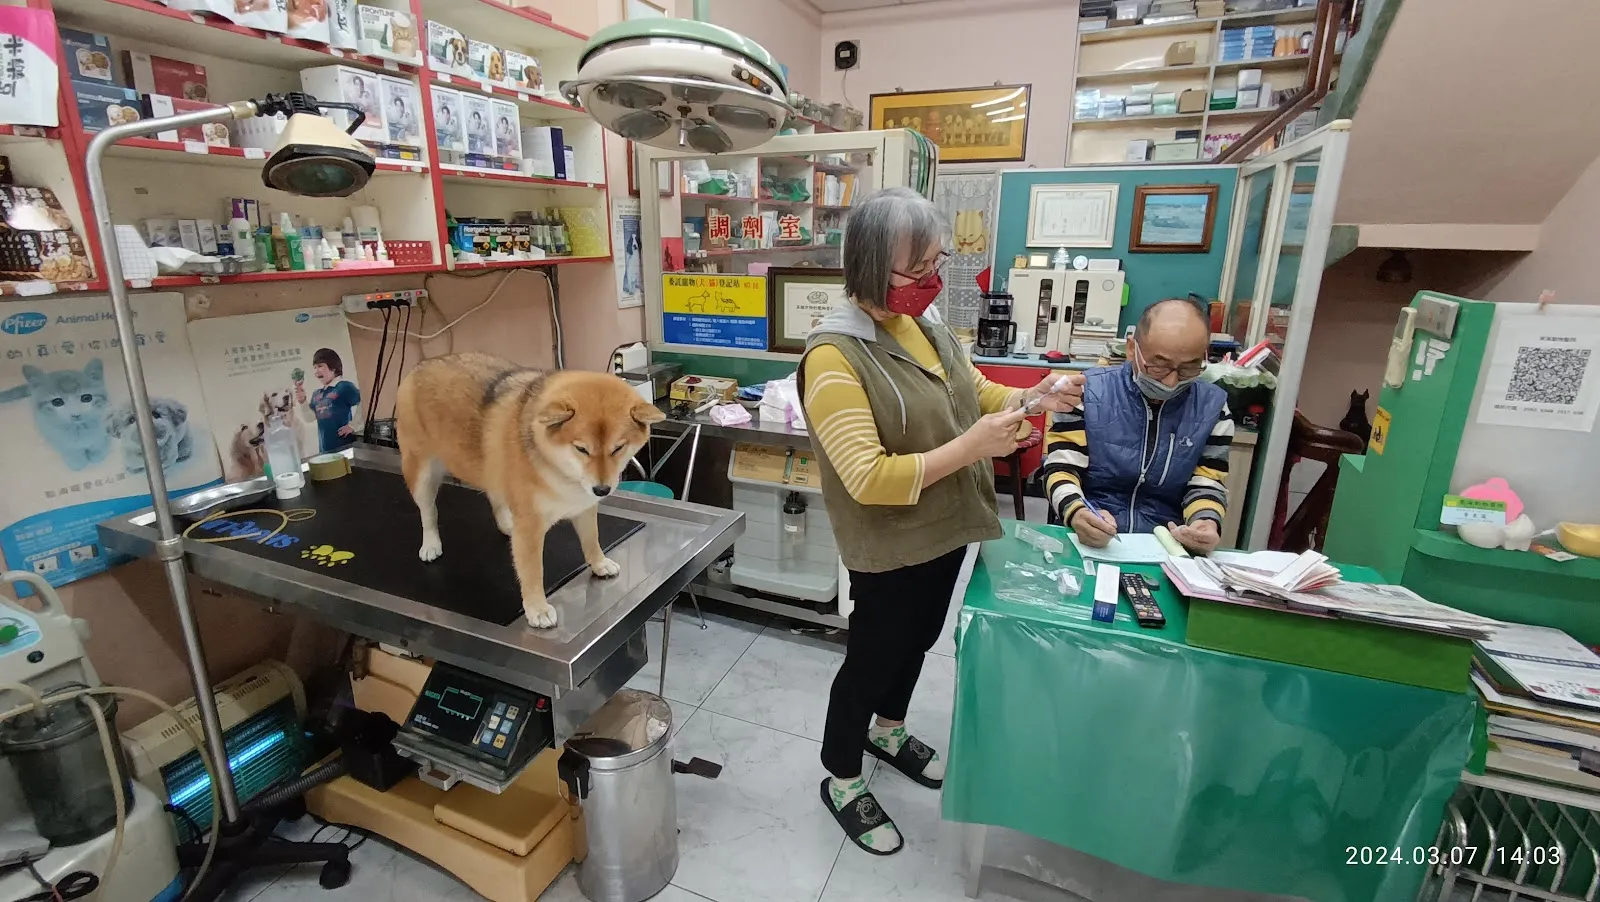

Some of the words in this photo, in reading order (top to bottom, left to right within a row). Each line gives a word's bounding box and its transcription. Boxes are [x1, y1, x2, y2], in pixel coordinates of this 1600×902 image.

[361, 6, 395, 18] FRONTLINE
[709, 214, 803, 240] 調劑室
[56, 313, 99, 325] Animal
